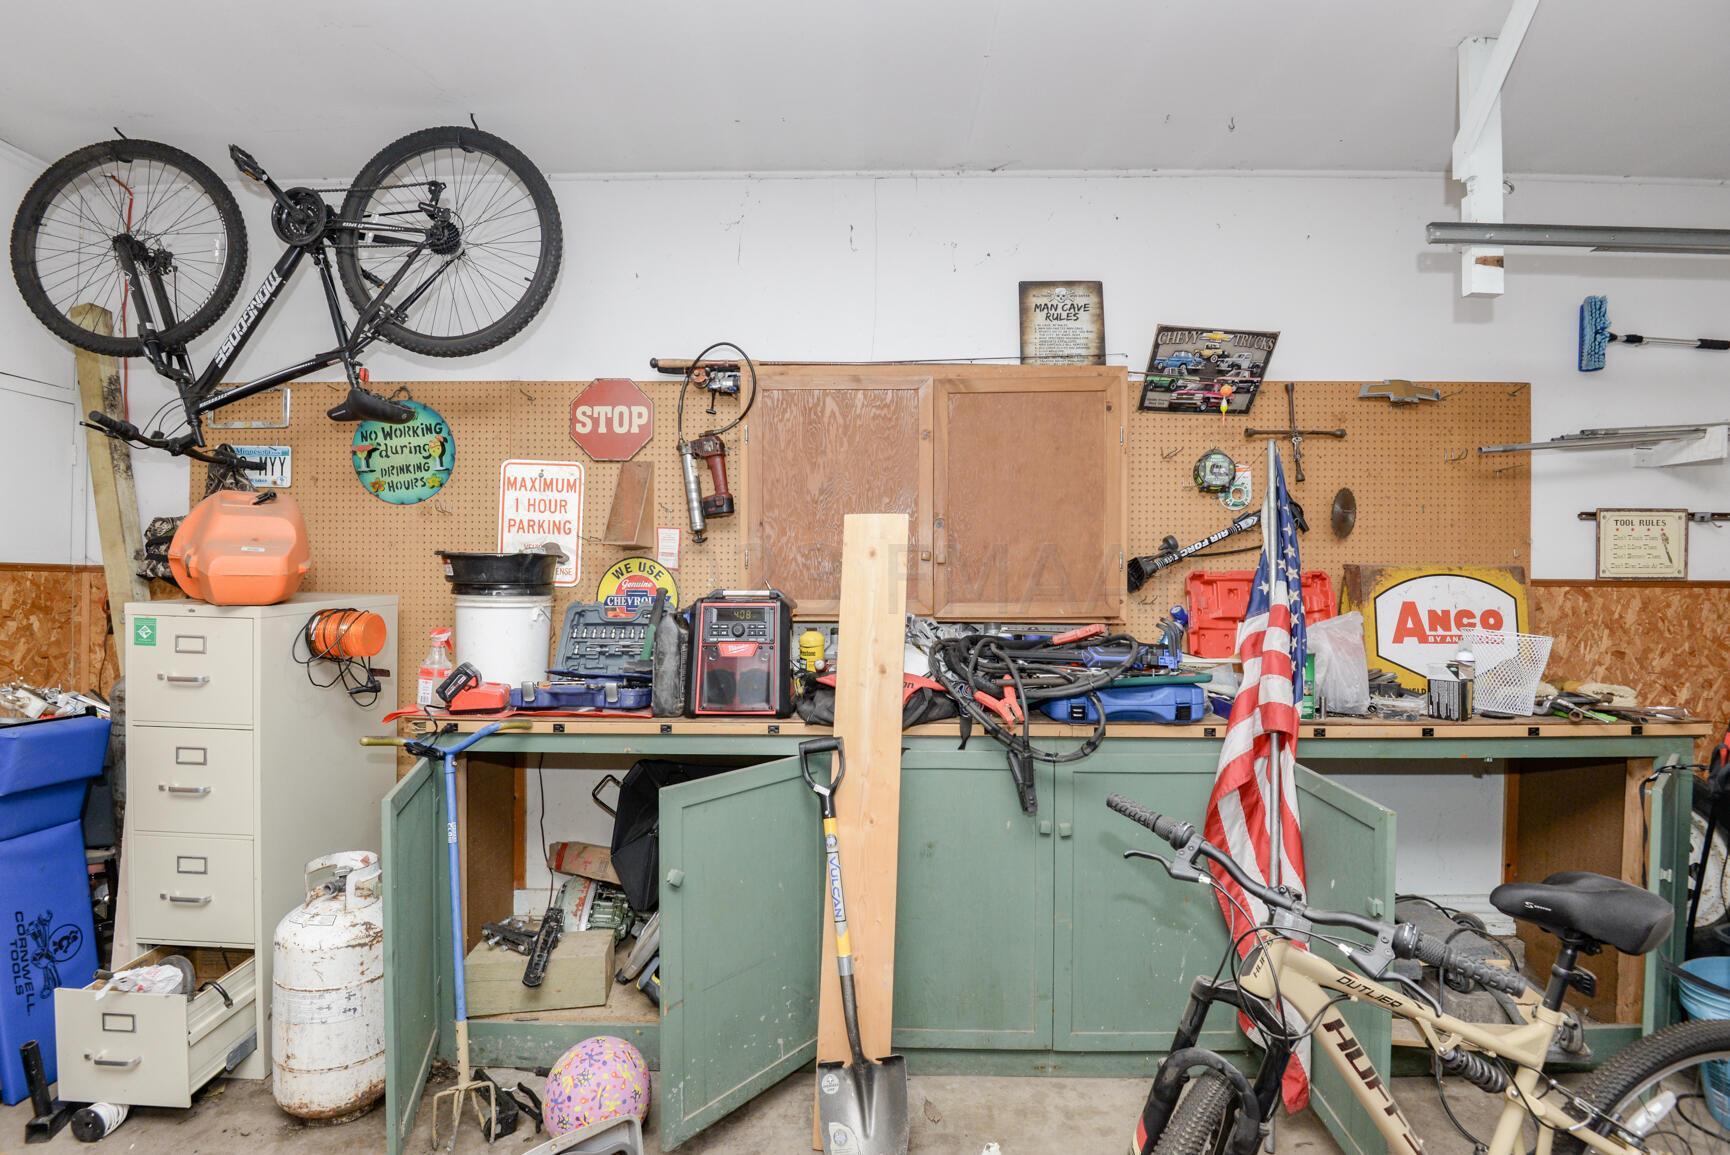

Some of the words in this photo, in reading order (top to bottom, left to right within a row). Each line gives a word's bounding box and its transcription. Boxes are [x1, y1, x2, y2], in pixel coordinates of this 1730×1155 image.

[1034, 303, 1058, 313] MAN
[1061, 303, 1090, 313] CAVE
[214, 268, 283, 368] MONGOOSE
[1045, 312, 1079, 322] RULES
[1157, 331, 1200, 345] CHEVY
[1233, 333, 1276, 351] TRUCKS
[575, 405, 649, 434] STOP
[360, 430, 378, 442] NO
[381, 422, 443, 440] WORKING
[379, 442, 432, 460] during
[380, 462, 431, 478] DRINKING
[387, 476, 427, 492] HOURS
[507, 476, 577, 493] MAXIMUM
[515, 498, 519, 513] 1
[527, 498, 568, 514] HOUR
[507, 518, 572, 535] PARKING
[1614, 519, 1635, 527] TOOL
[1639, 519, 1667, 527] RULES
[1209, 529, 1229, 543] AIR
[1180, 540, 1211, 557] FORC
[612, 563, 632, 580] WE
[638, 562, 665, 580] USE
[622, 579, 653, 589] Genuine
[607, 596, 654, 606] CHEVROL
[829, 856, 843, 918] VULCAN
[10, 940, 24, 995] TOOLS
[15, 911, 35, 1016] CORNWELL
[1336, 975, 1403, 1009] OUTLIER
